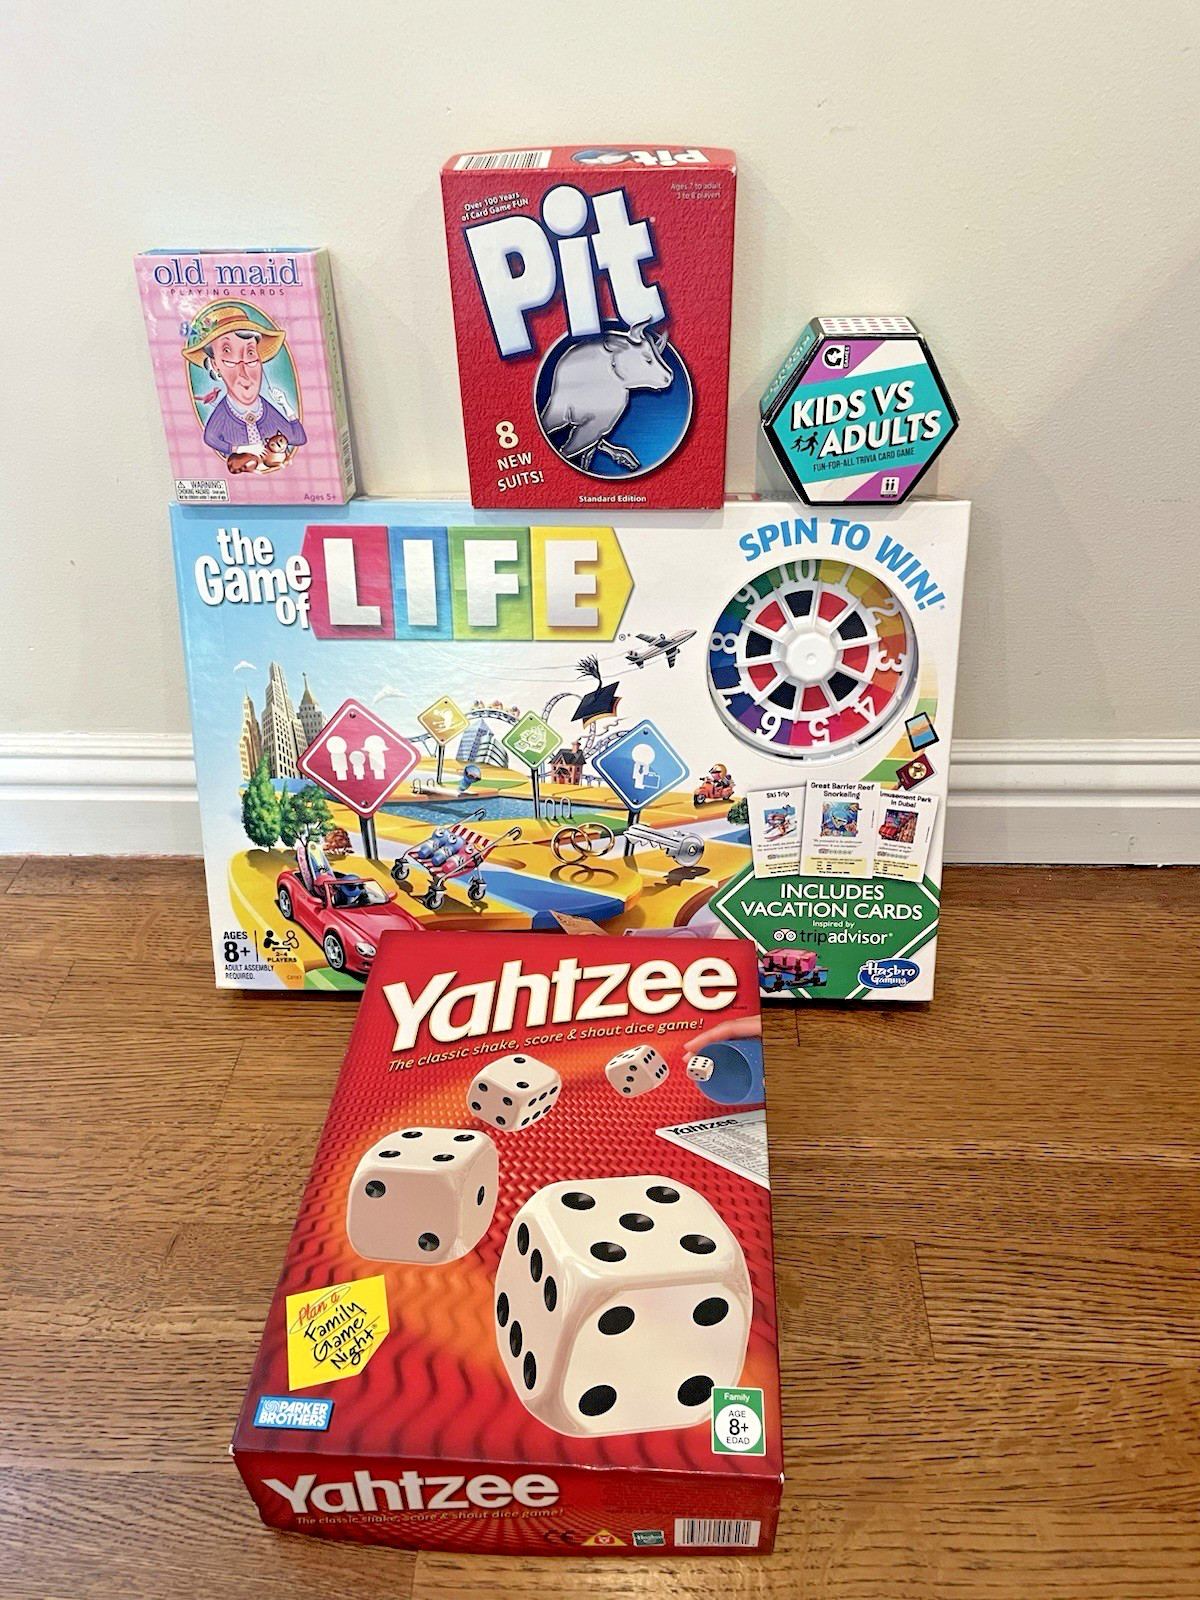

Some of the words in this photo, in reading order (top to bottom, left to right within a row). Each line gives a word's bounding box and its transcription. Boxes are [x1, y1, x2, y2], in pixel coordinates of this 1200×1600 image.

[671, 183, 688, 191] Ages
[697, 192, 721, 200] players
[464, 202, 482, 211] Over
[484, 197, 498, 206] 100
[499, 192, 520, 202] Years
[470, 209, 489, 219] Card
[489, 204, 511, 214] Game
[512, 198, 529, 208] FUN
[154, 258, 206, 285] old
[215, 258, 301, 286] maid
[465, 185, 665, 357] Pit
[170, 288, 230, 296] PLAYING
[240, 288, 285, 296] CARDS
[792, 389, 868, 430] KIDS
[872, 380, 915, 416] VS
[495, 420, 519, 449] 8
[819, 410, 943, 459] ADULTS
[496, 452, 533, 471] NEW
[813, 459, 855, 472] FUN-FOR-ALL
[856, 454, 877, 465] TRIVIA
[878, 450, 895, 461] CARD
[896, 448, 915, 458] GAME
[497, 471, 545, 492] SUITS!
[303, 493, 323, 502] Ages
[324, 493, 337, 501] 5+
[217, 527, 274, 566] the
[739, 517, 818, 561] SPIN
[830, 518, 871, 551] TO
[874, 535, 946, 611] WIN!
[779, 559, 817, 585] 10
[194, 554, 312, 606] Game
[323, 538, 599, 627] LIFE
[275, 592, 310, 629] of
[733, 588, 762, 612] 9
[867, 597, 901, 626] 2
[709, 632, 738, 655] 8
[877, 650, 907, 672] 3
[852, 695, 879, 724] 4
[808, 717, 830, 745] 5
[823, 790, 860, 800] Snorkeling
[832, 782, 856, 790] Barrier
[897, 800, 916, 808] Dubai
[780, 883, 885, 900] INCLUDES
[741, 901, 847, 919] VACATION
[853, 903, 923, 920] CARDS
[223, 931, 248, 940] AGES
[812, 920, 843, 930] Inspired
[844, 921, 855, 929] by
[800, 930, 888, 946] tripadvisor
[224, 941, 250, 962] 8+
[224, 964, 242, 972] ADULT
[244, 964, 274, 972] ASSEMBLY
[225, 972, 256, 980] REQUIRED.
[864, 961, 917, 978] Hasbro
[870, 973, 908, 986] Gaming
[383, 957, 738, 1052] Yahtzee
[389, 1058, 414, 1072] The
[417, 1046, 470, 1066] classic
[472, 1039, 520, 1056] shake,
[524, 1032, 563, 1047] score
[566, 1028, 577, 1040] &
[580, 1025, 622, 1039] shout
[625, 1022, 654, 1034] dice
[657, 1018, 704, 1034] game!
[666, 1119, 739, 1135] Yahtzee
[298, 1301, 328, 1326] Plan
[331, 1292, 340, 1303] a
[304, 1301, 367, 1342] Family
[313, 1317, 364, 1362] Game
[331, 1329, 375, 1370] Night
[279, 1401, 329, 1415] PARKER
[723, 1393, 751, 1403] Family
[258, 1413, 327, 1427] BROTHERS
[728, 1410, 746, 1418] AGE
[729, 1418, 749, 1435] 8+
[726, 1437, 750, 1445] EDAD
[261, 1470, 560, 1513] Yahtzee
[296, 1517, 316, 1525] The
[319, 1515, 359, 1524] classic
[361, 1514, 401, 1523] shake,
[402, 1513, 437, 1521] score
[440, 1512, 449, 1520] &
[450, 1511, 488, 1520] shout
[491, 1510, 519, 1518] dice
[521, 1509, 563, 1518] game!
